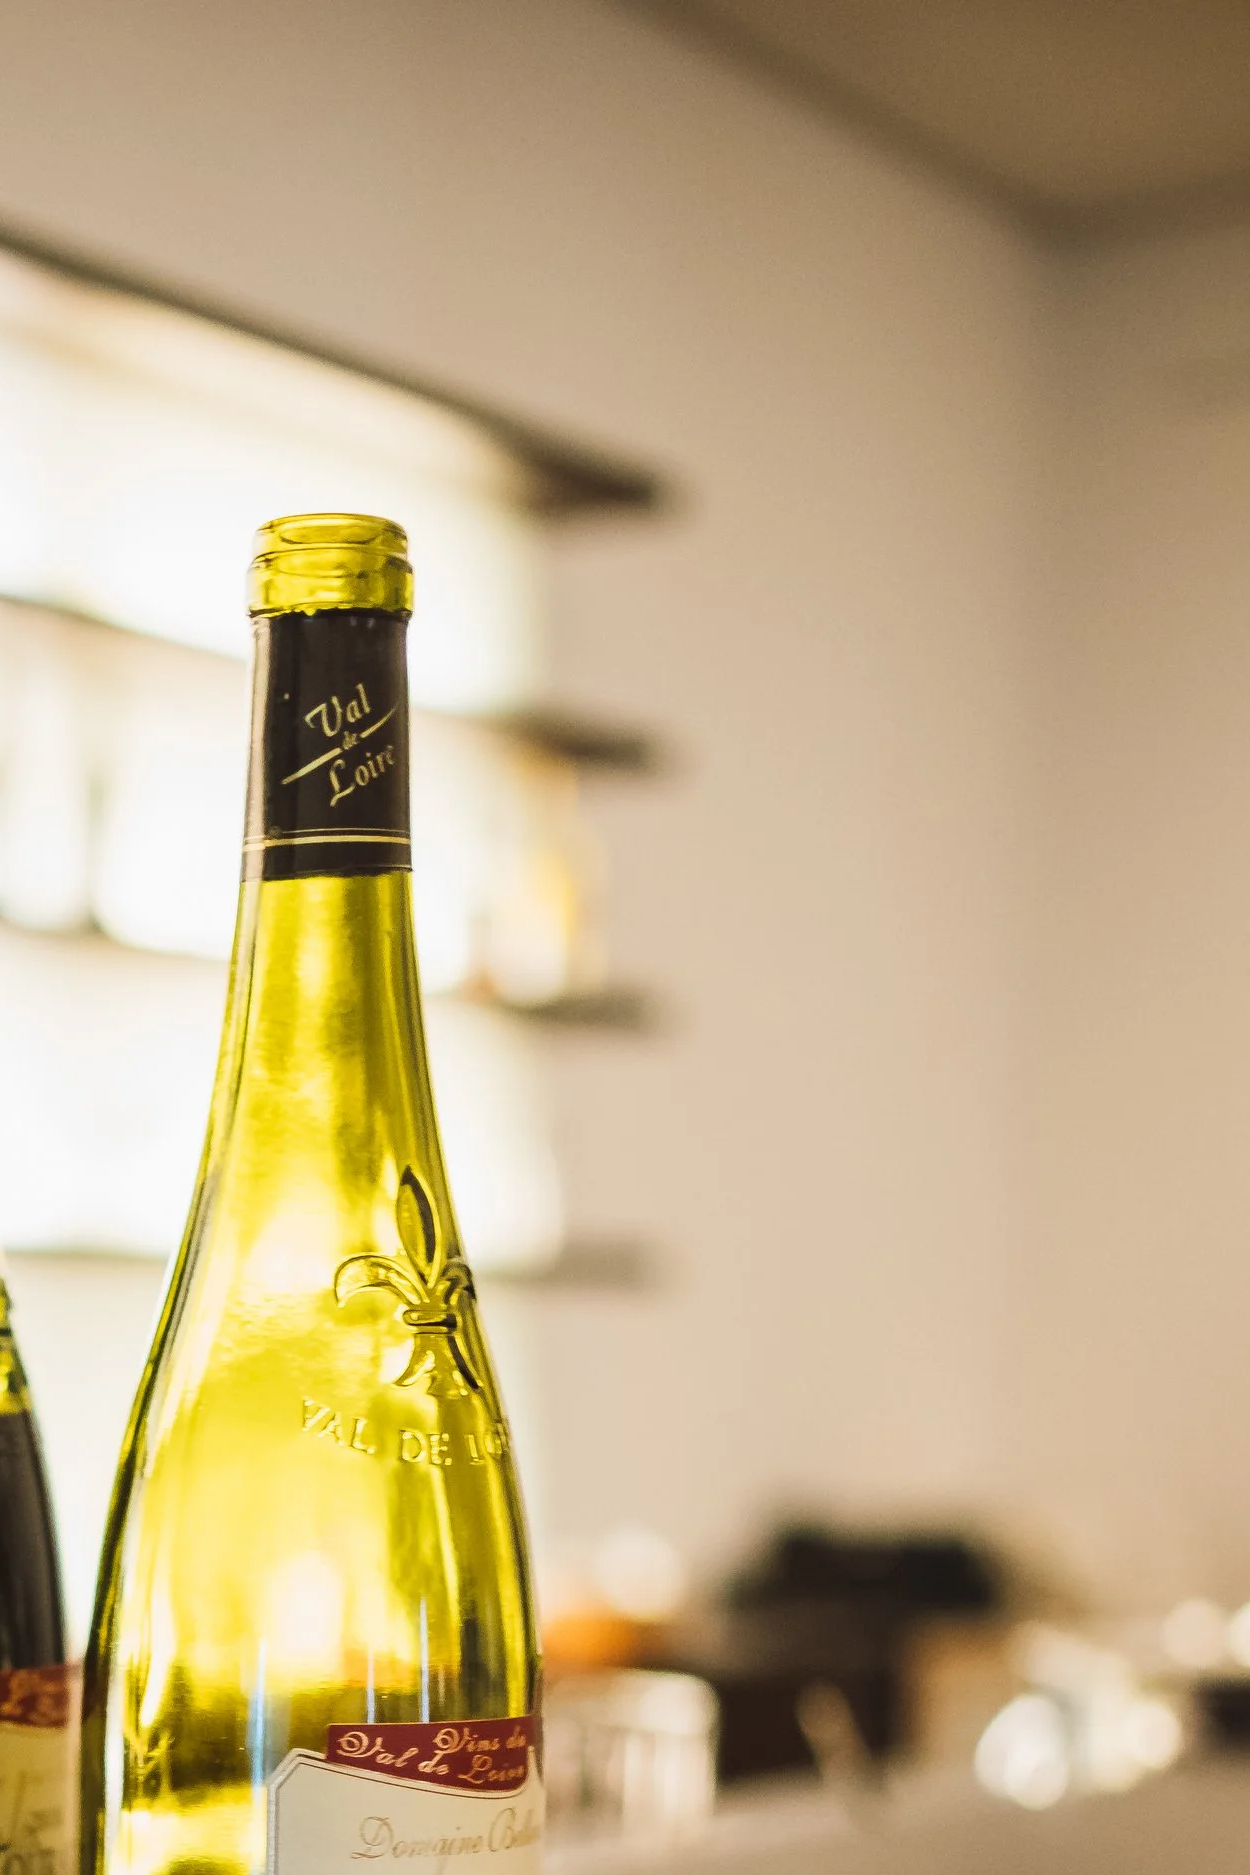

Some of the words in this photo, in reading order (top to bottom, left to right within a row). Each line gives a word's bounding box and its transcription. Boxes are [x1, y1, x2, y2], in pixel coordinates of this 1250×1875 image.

[303, 683, 371, 737] Val
[329, 745, 395, 807] Loire
[301, 1396, 377, 1454] VAL
[399, 1429, 453, 1466] DE
[336, 1731, 419, 1768] Val
[418, 1751, 450, 1775] de
[432, 1728, 501, 1754] Vins
[350, 1815, 483, 1859] Domaine
